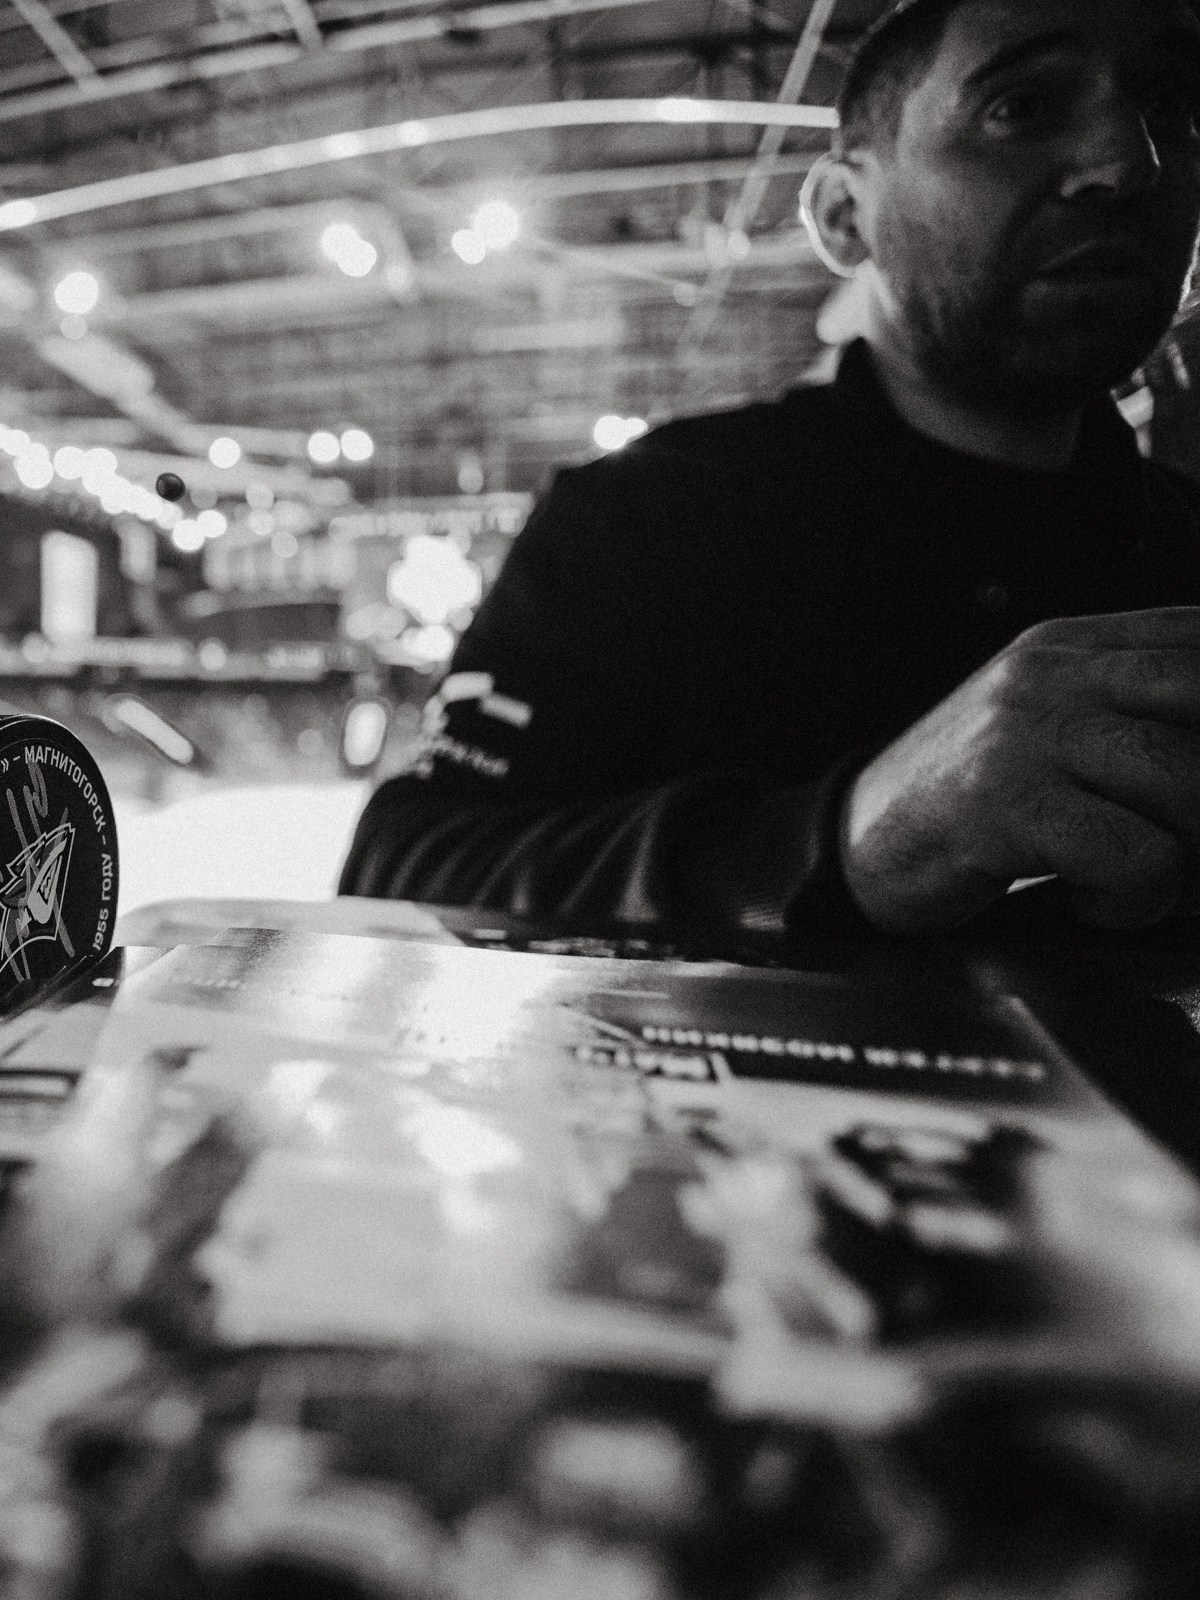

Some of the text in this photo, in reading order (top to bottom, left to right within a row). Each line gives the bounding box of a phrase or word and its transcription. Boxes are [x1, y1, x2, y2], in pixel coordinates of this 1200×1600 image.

[24, 745, 107, 833] МАГНИТОГОРСК
[92, 853, 114, 951] 1955 ГОДУ
